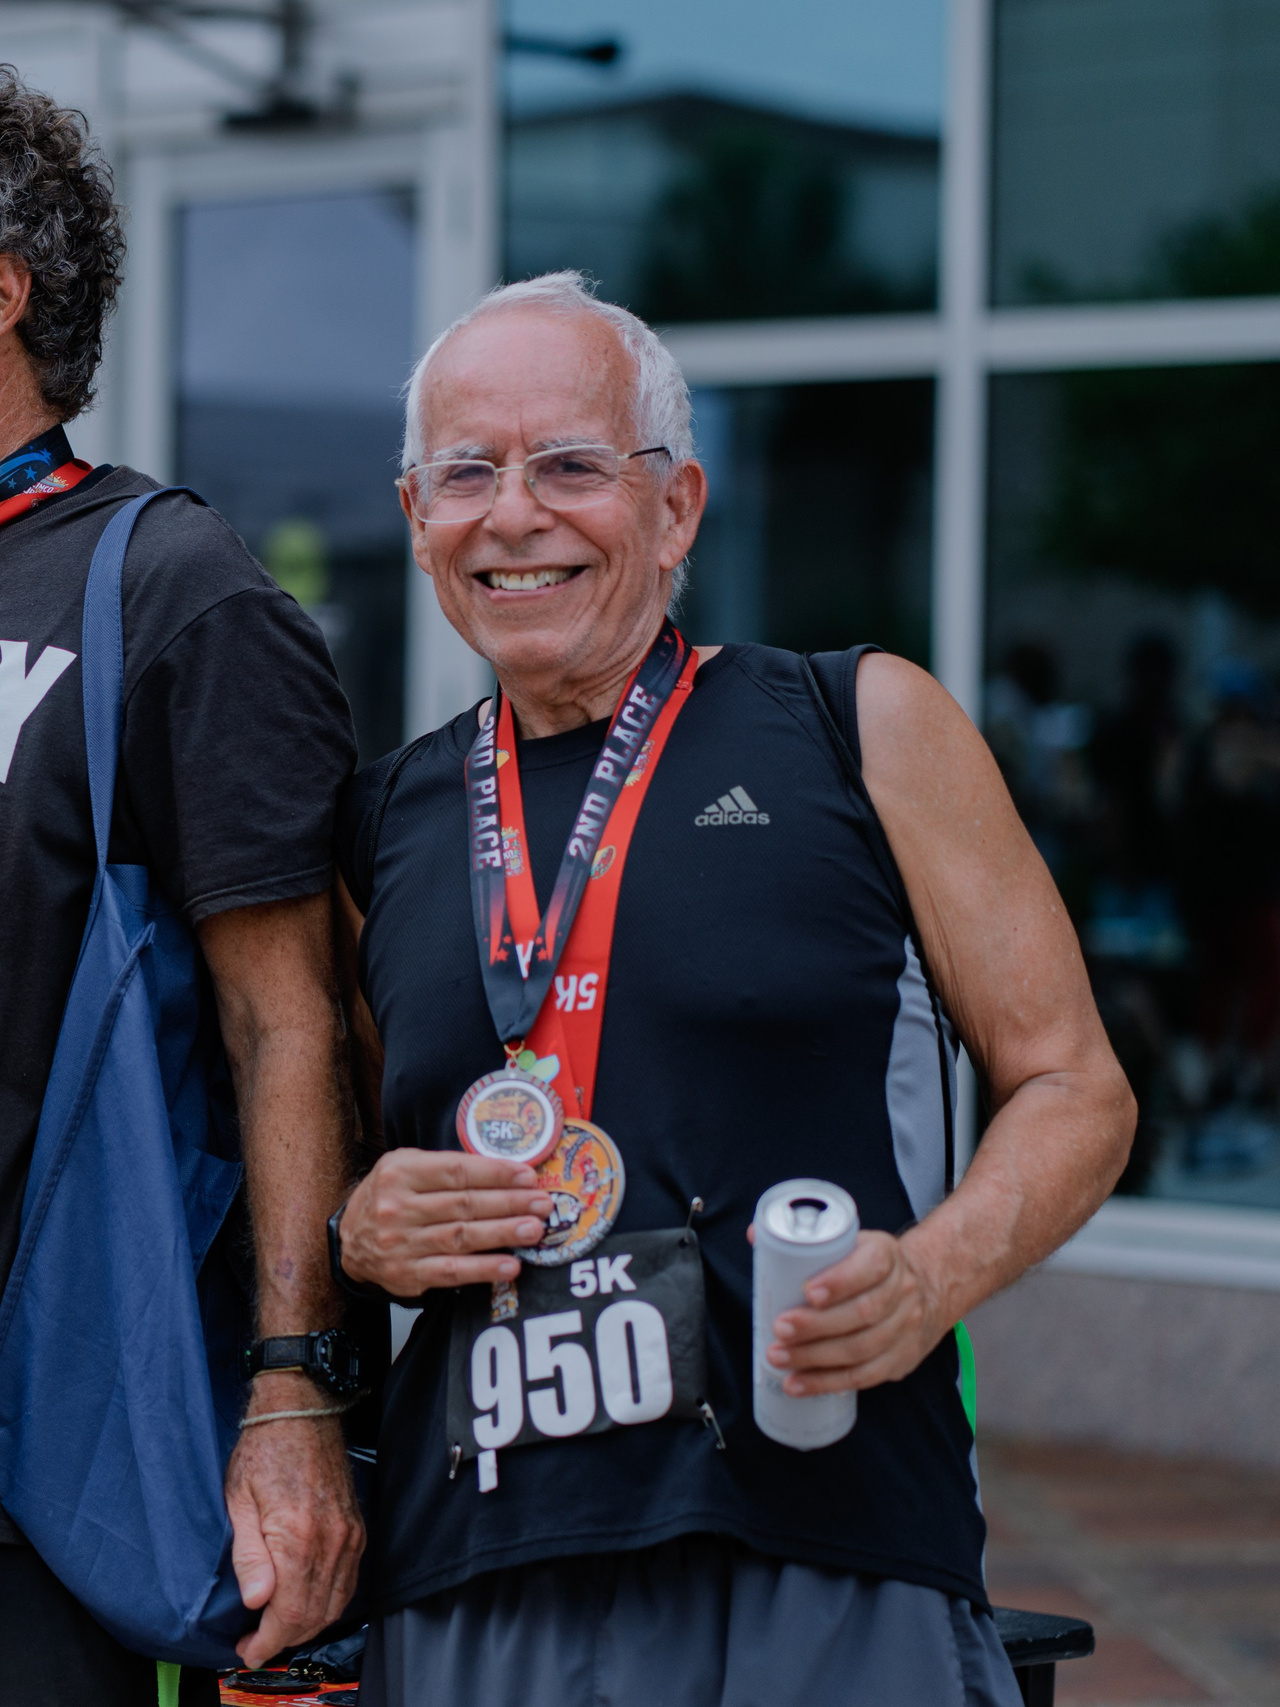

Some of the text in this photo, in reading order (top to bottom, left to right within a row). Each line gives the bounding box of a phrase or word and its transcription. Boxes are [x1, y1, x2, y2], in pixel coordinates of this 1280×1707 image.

[569, 684, 660, 861] 2ND PLACE
[473, 776, 502, 870] PLACE
[694, 810, 771, 826] adidas
[554, 973, 599, 1012] 5K
[569, 1254, 637, 1298] 5K
[471, 1300, 674, 1450] 950
